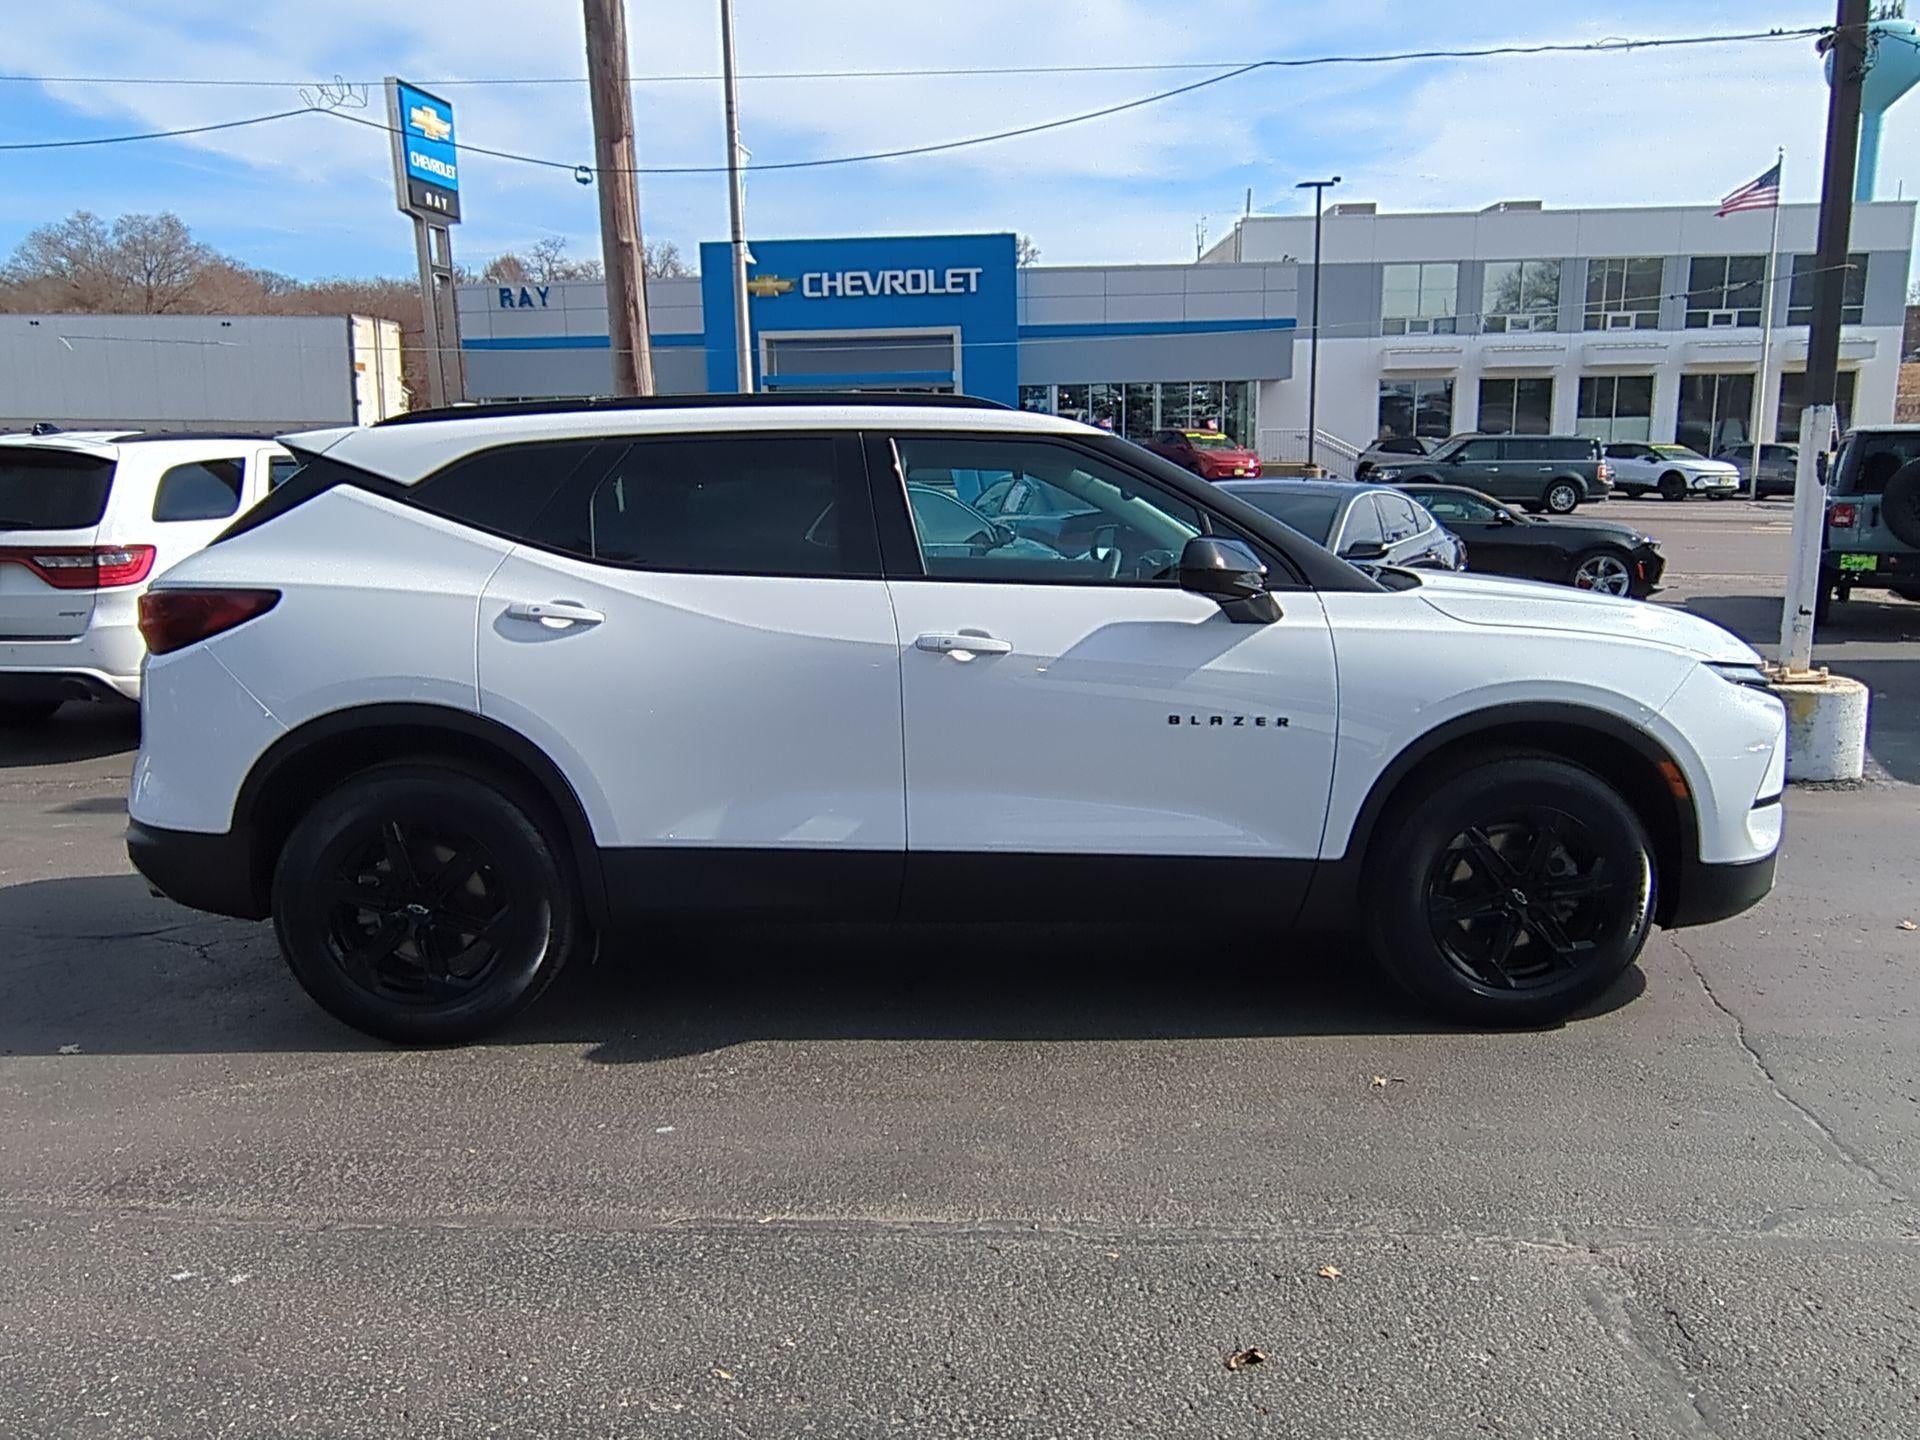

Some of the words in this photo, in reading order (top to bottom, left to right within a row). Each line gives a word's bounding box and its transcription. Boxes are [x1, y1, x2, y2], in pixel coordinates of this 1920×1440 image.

[410, 151, 456, 180] CHEVROLET
[425, 192, 447, 211] RAY
[802, 267, 983, 298] CHEVROLET
[499, 286, 549, 308] RAY
[1168, 715, 1289, 727] BLAZER
